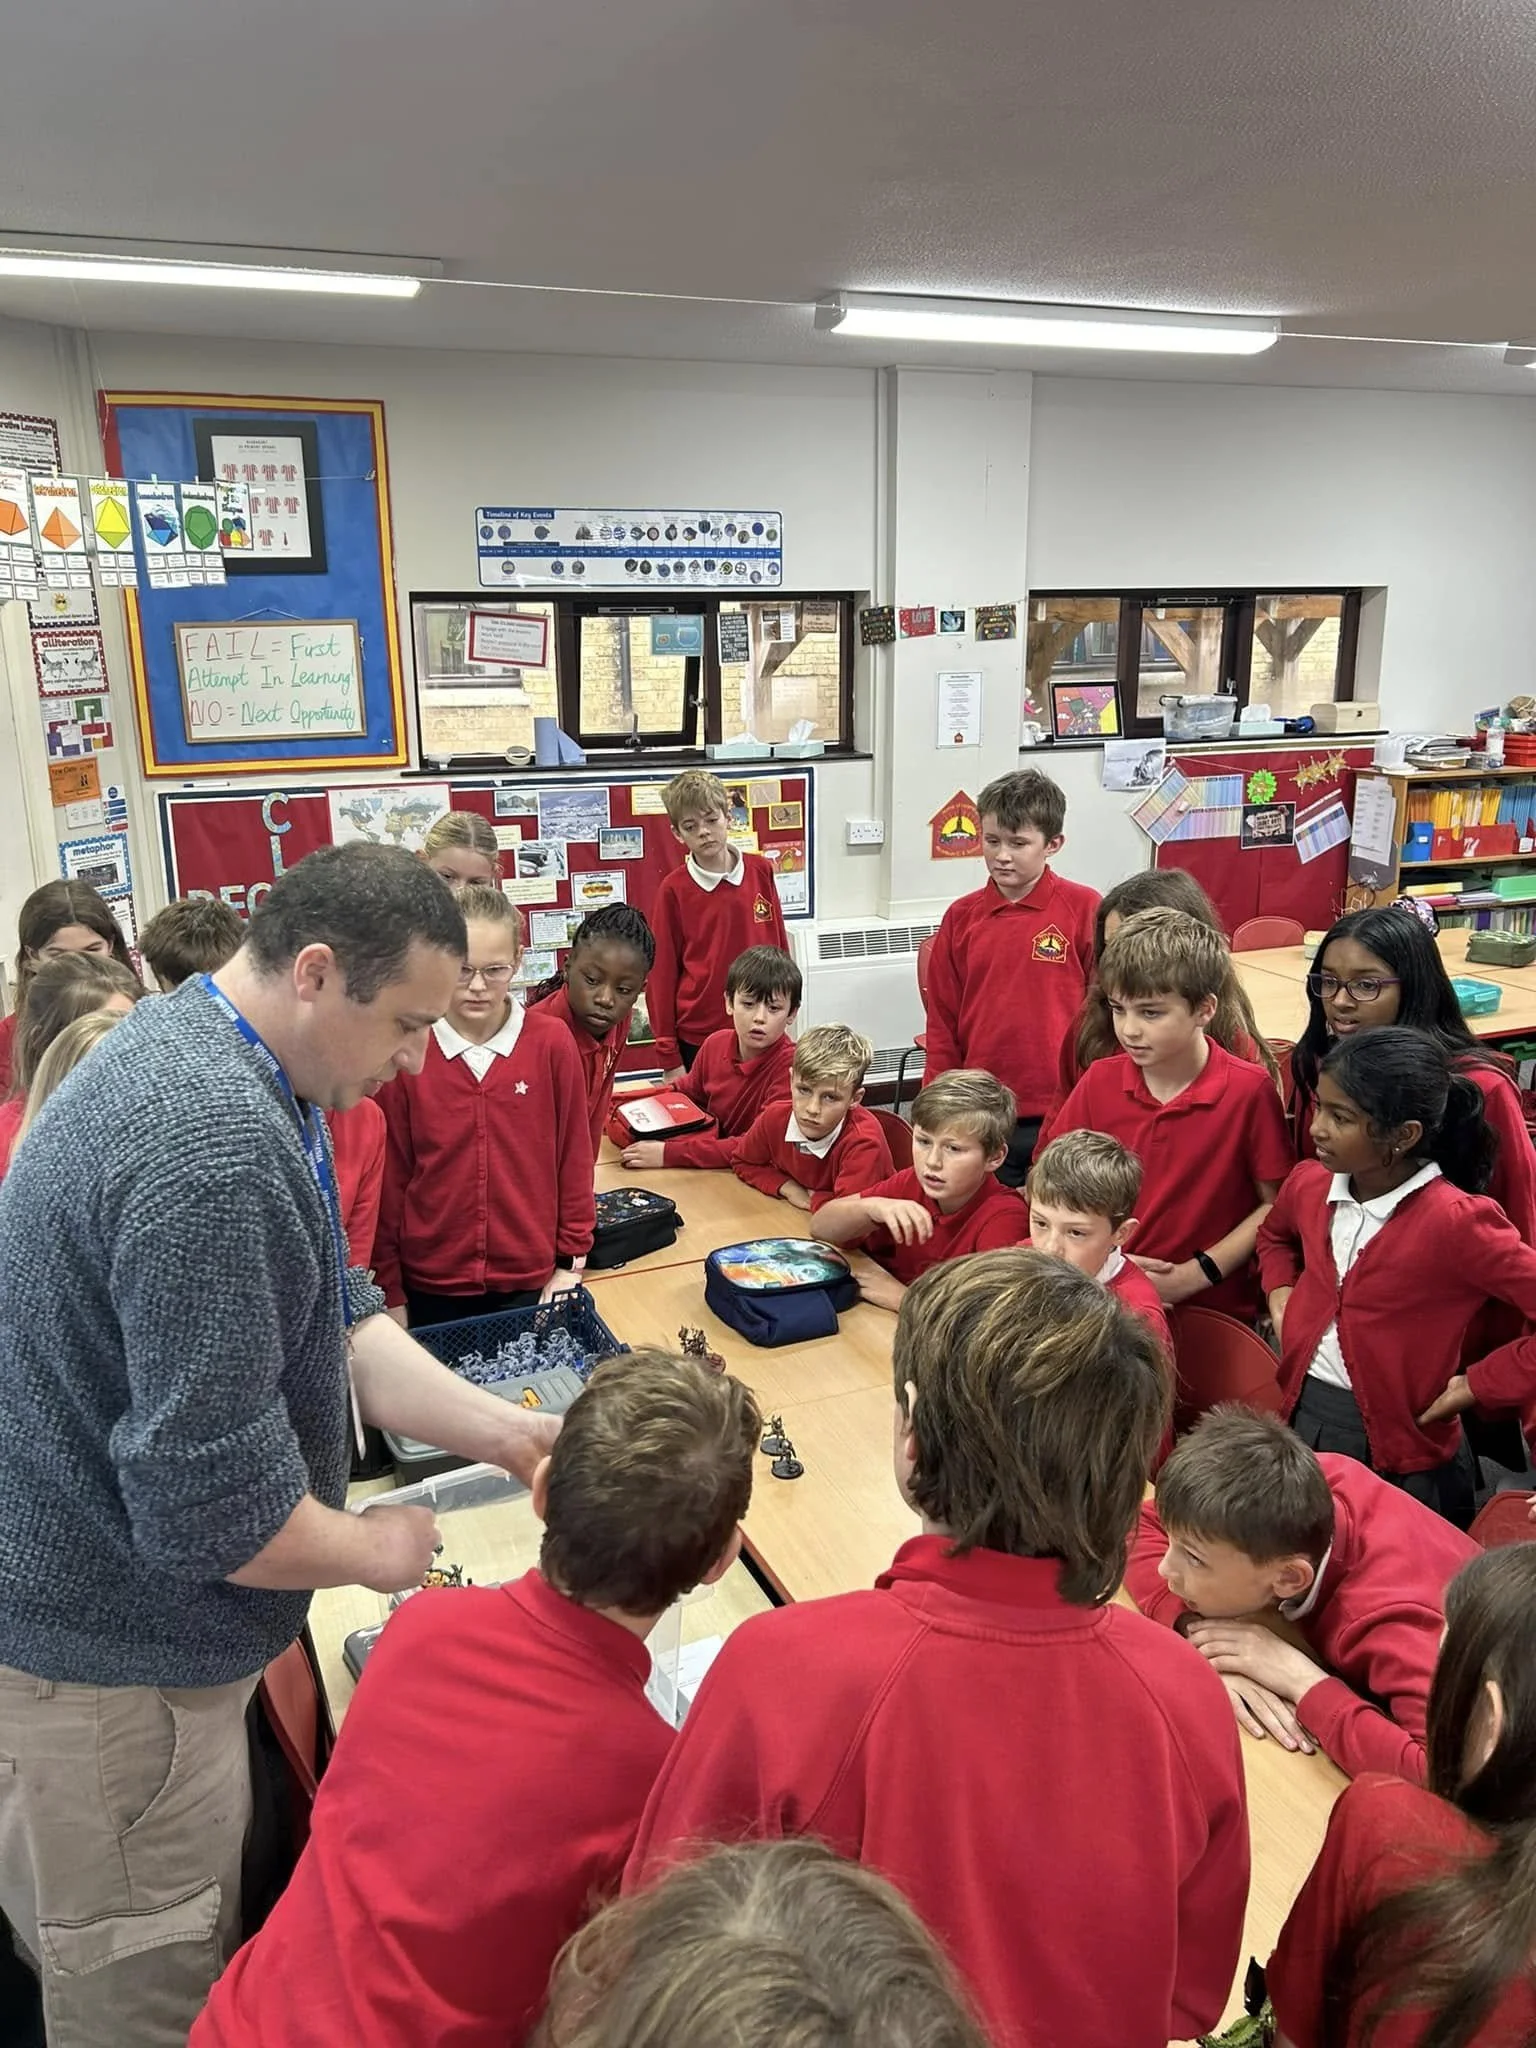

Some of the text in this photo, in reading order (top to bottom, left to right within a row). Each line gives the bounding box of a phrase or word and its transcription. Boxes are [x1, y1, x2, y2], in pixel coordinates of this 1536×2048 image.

[41, 638, 95, 648] alliteration
[290, 632, 341, 661] First
[187, 664, 249, 694] Attempt
[260, 665, 284, 688] In
[241, 700, 285, 726] Next
[289, 699, 356, 730] Opportunity
[73, 843, 116, 857] metaphor
[254, 1041, 280, 1073] VISITOR
